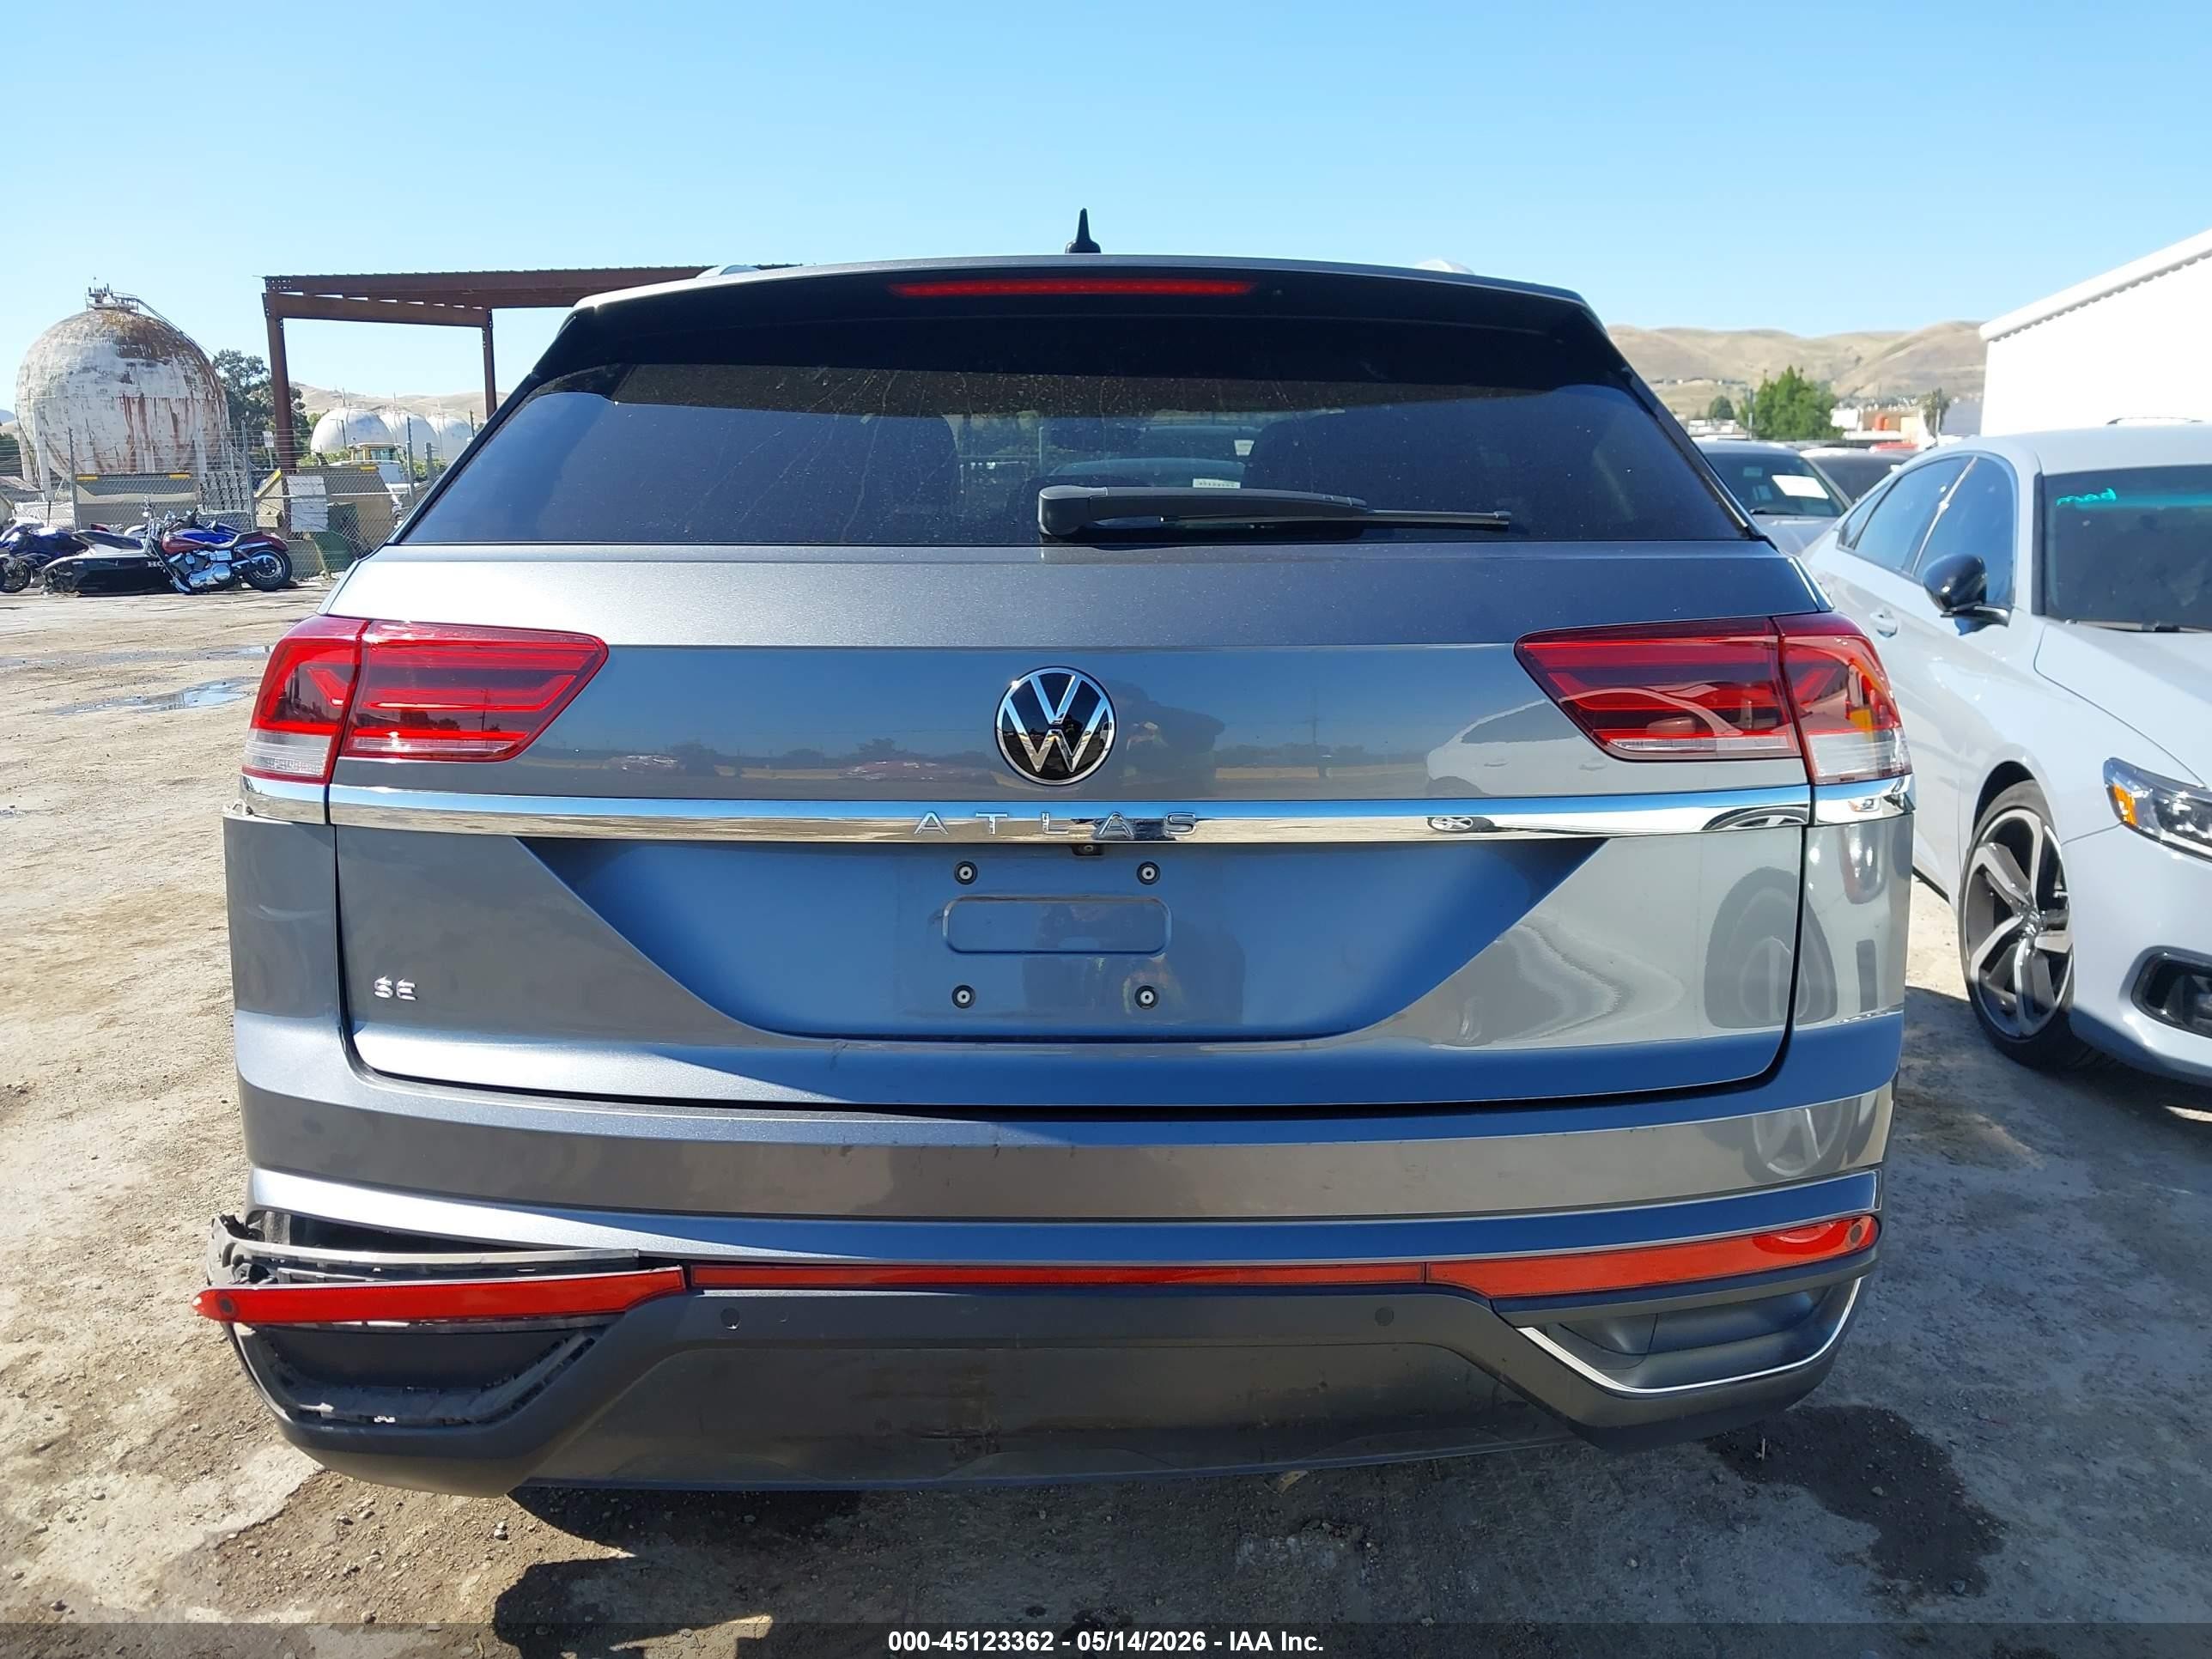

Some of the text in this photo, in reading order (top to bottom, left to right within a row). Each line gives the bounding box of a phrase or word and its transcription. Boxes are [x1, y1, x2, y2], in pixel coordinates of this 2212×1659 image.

[998, 669, 1114, 775] VW
[913, 811, 1196, 838] ATLAS
[374, 975, 417, 1001] SE
